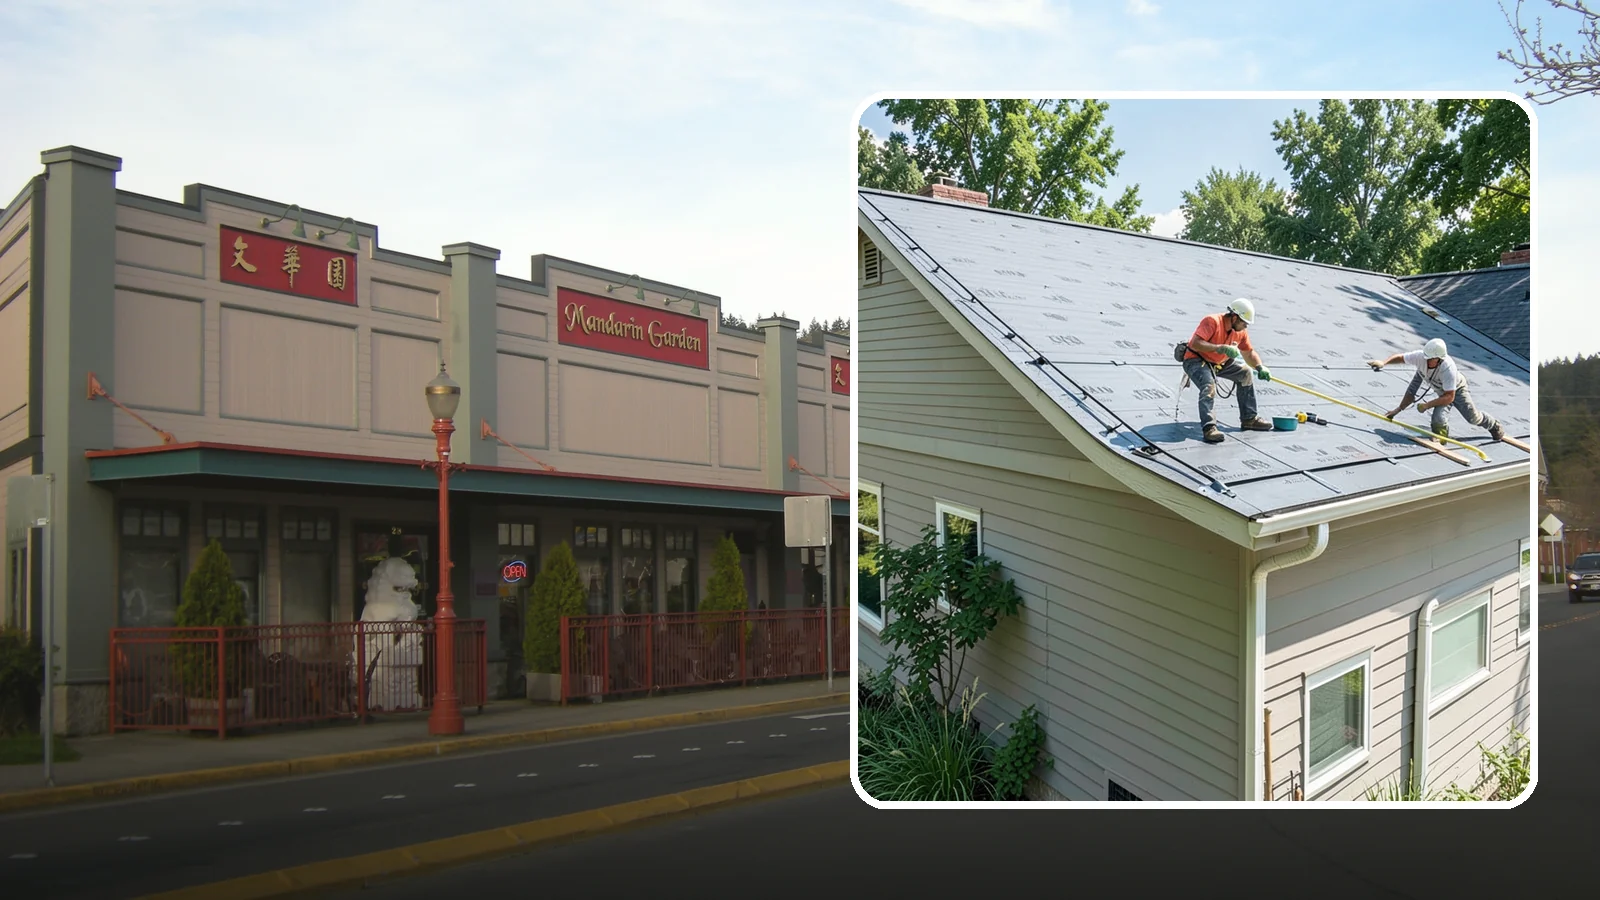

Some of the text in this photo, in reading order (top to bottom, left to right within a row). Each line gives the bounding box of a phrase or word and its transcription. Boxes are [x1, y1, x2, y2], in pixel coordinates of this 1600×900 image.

[564, 302, 701, 352] Mandarin Garden
[503, 565, 527, 578] OPEN
